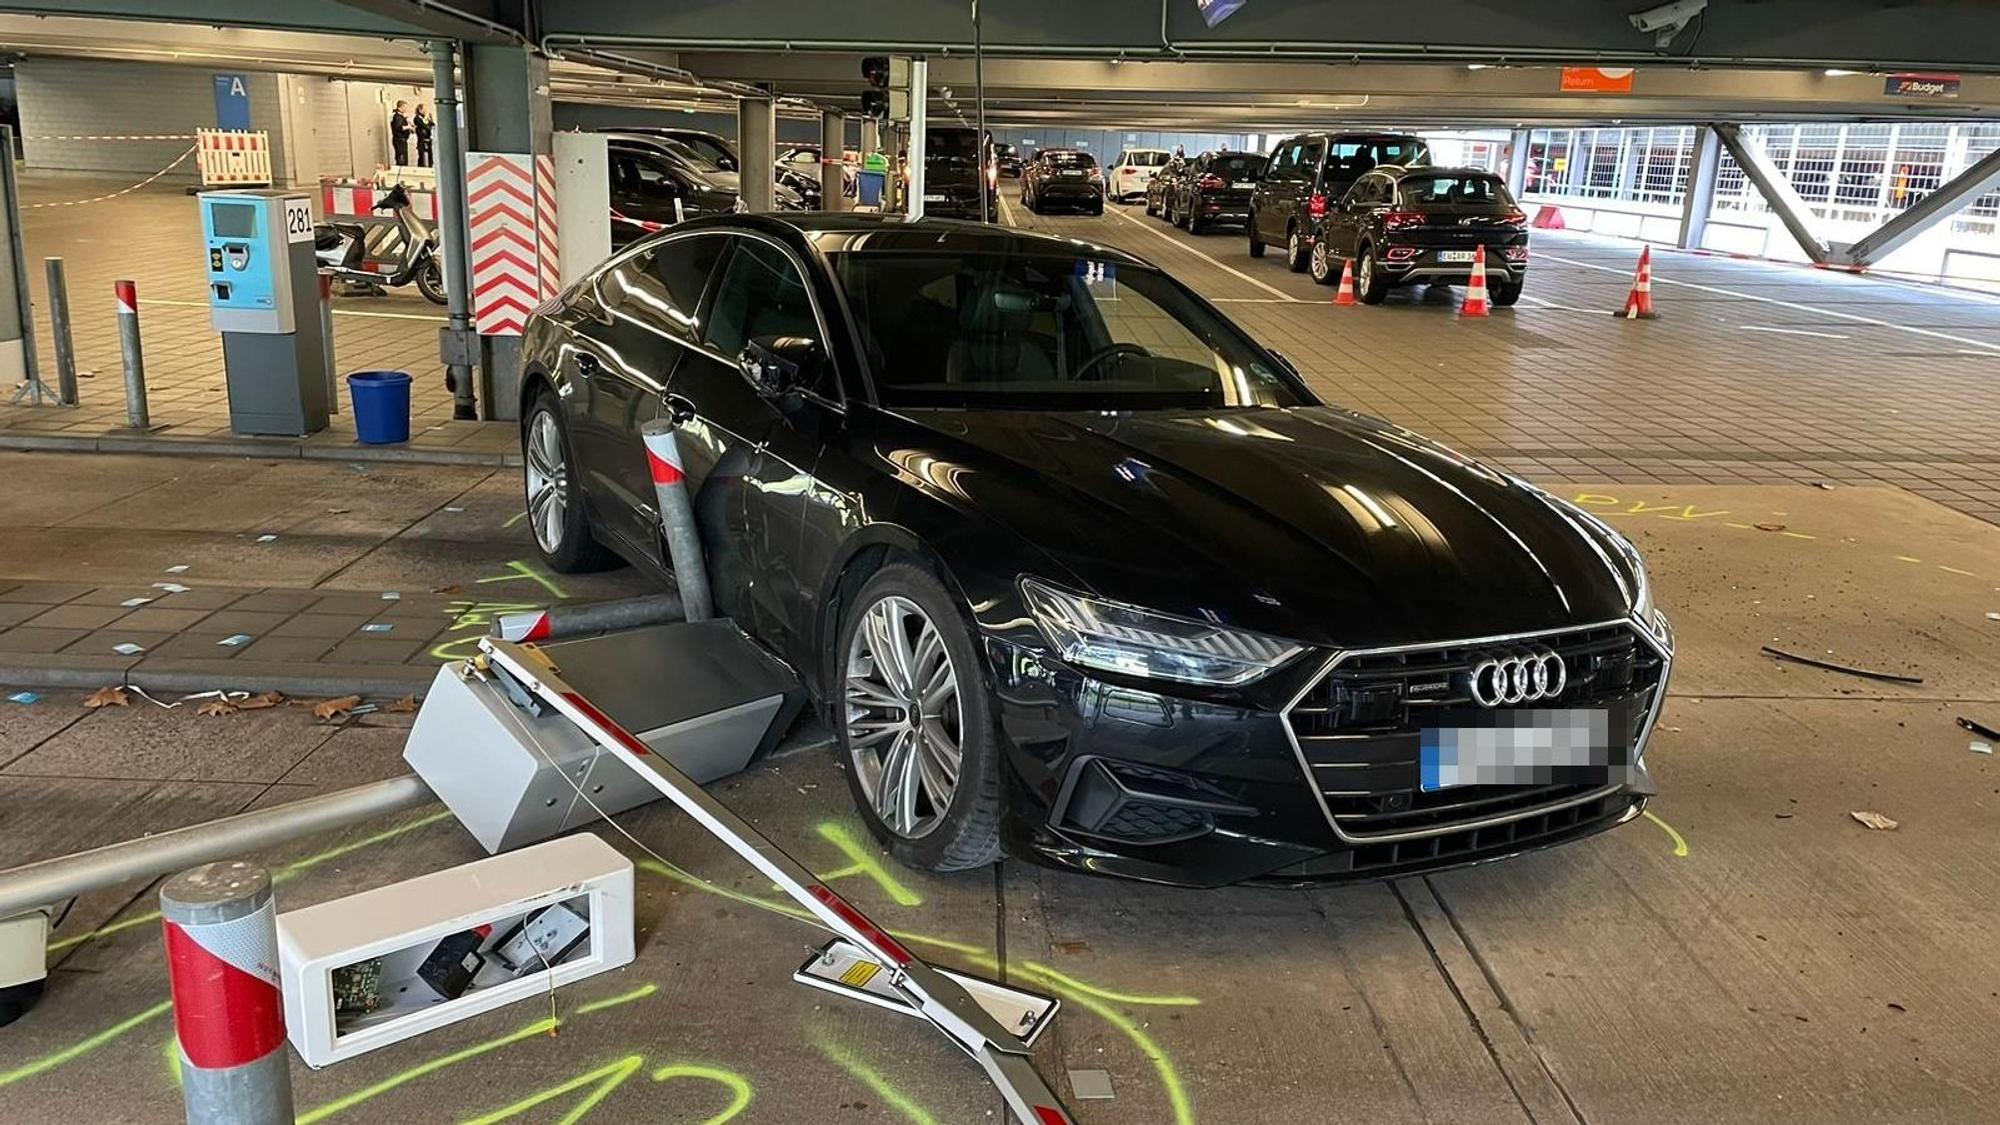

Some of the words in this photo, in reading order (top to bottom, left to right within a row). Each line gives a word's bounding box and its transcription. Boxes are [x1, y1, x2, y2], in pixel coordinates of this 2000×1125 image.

[231, 76, 246, 96] A
[1912, 81, 1944, 94] Budget
[288, 208, 312, 233] 281
